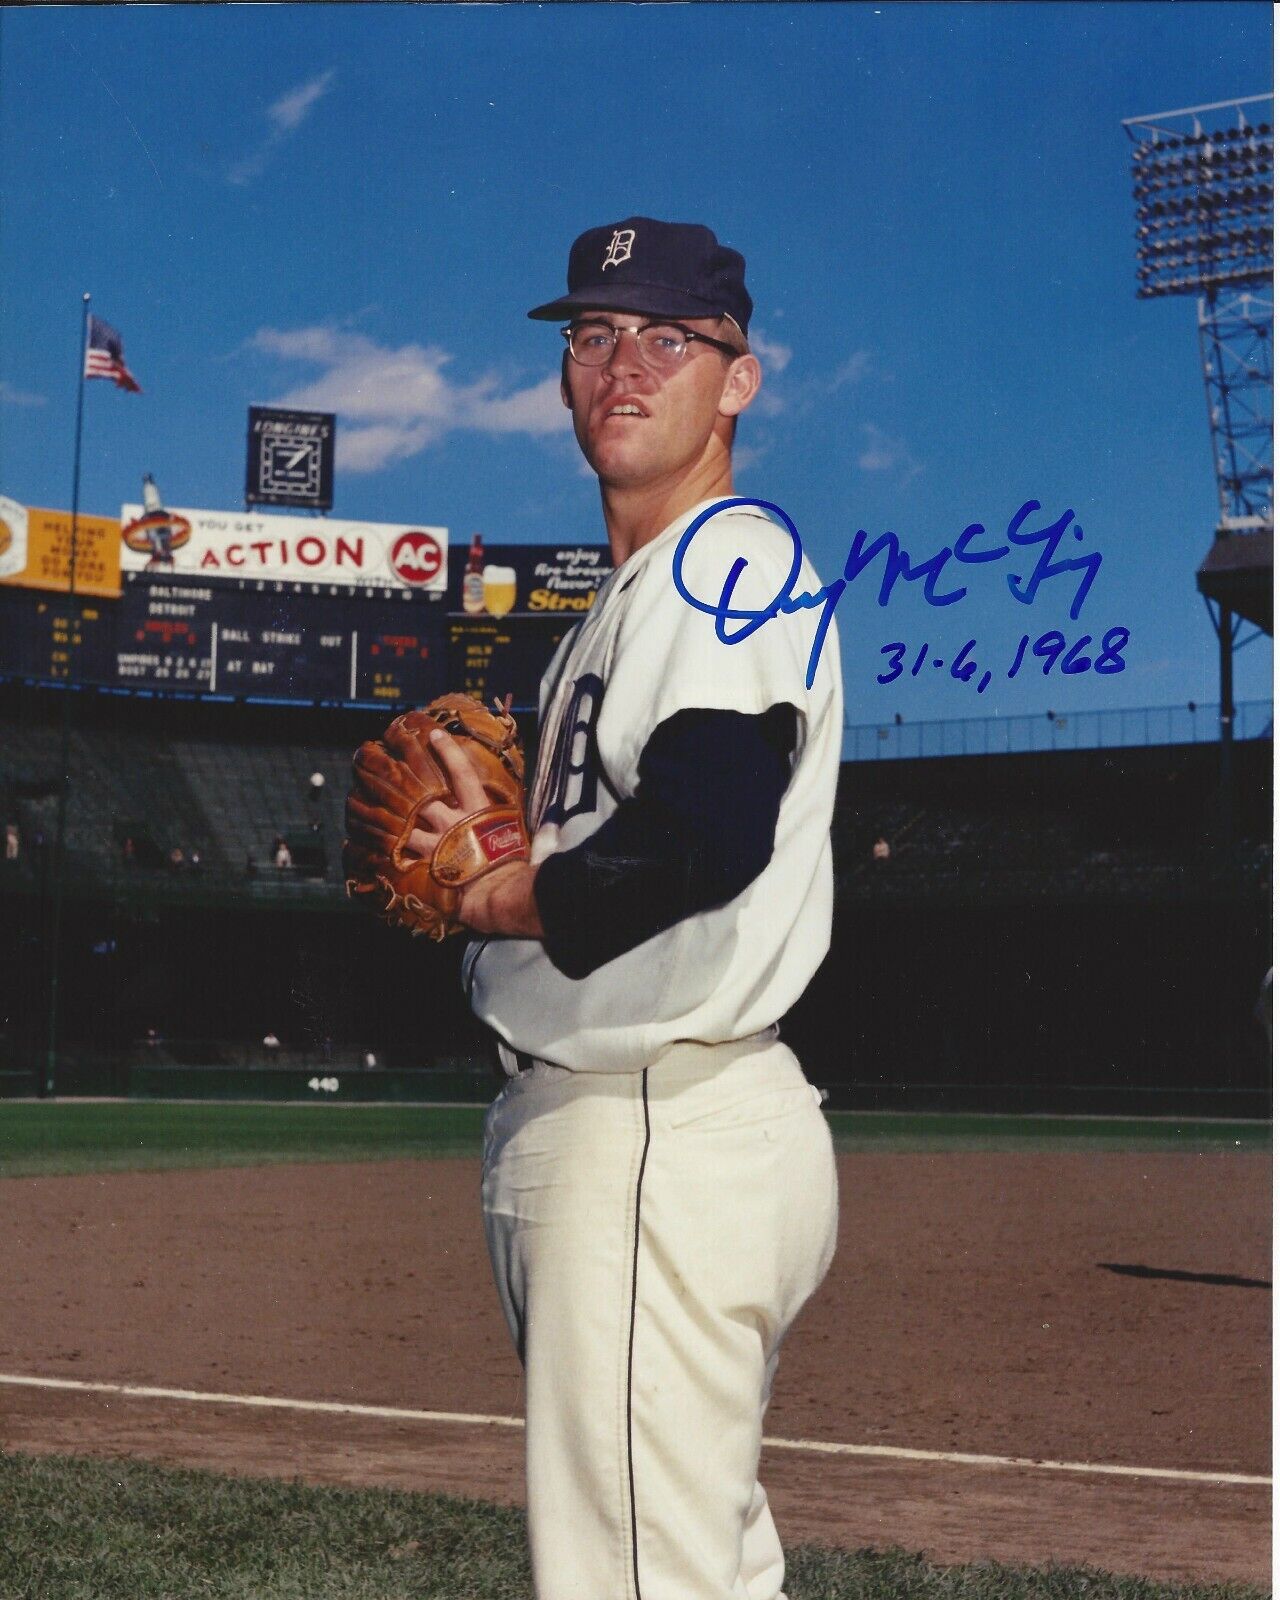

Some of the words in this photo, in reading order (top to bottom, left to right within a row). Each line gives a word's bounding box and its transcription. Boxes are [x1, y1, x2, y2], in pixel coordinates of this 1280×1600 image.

[602, 230, 636, 272] D
[198, 519, 229, 532] YOU
[234, 521, 264, 533] GET
[200, 536, 363, 568] ACTION
[394, 542, 440, 572] AC
[556, 547, 600, 566] enjoy
[534, 562, 616, 576] fire-brewe
[148, 585, 212, 601] BALTIMORE
[148, 602, 196, 616] DETROIT
[221, 628, 250, 643] BALL
[262, 630, 301, 646] STRIKE
[320, 635, 343, 648] OUT
[1007, 626, 1130, 679] 1968
[226, 660, 242, 673] AT
[252, 660, 275, 675] BAT
